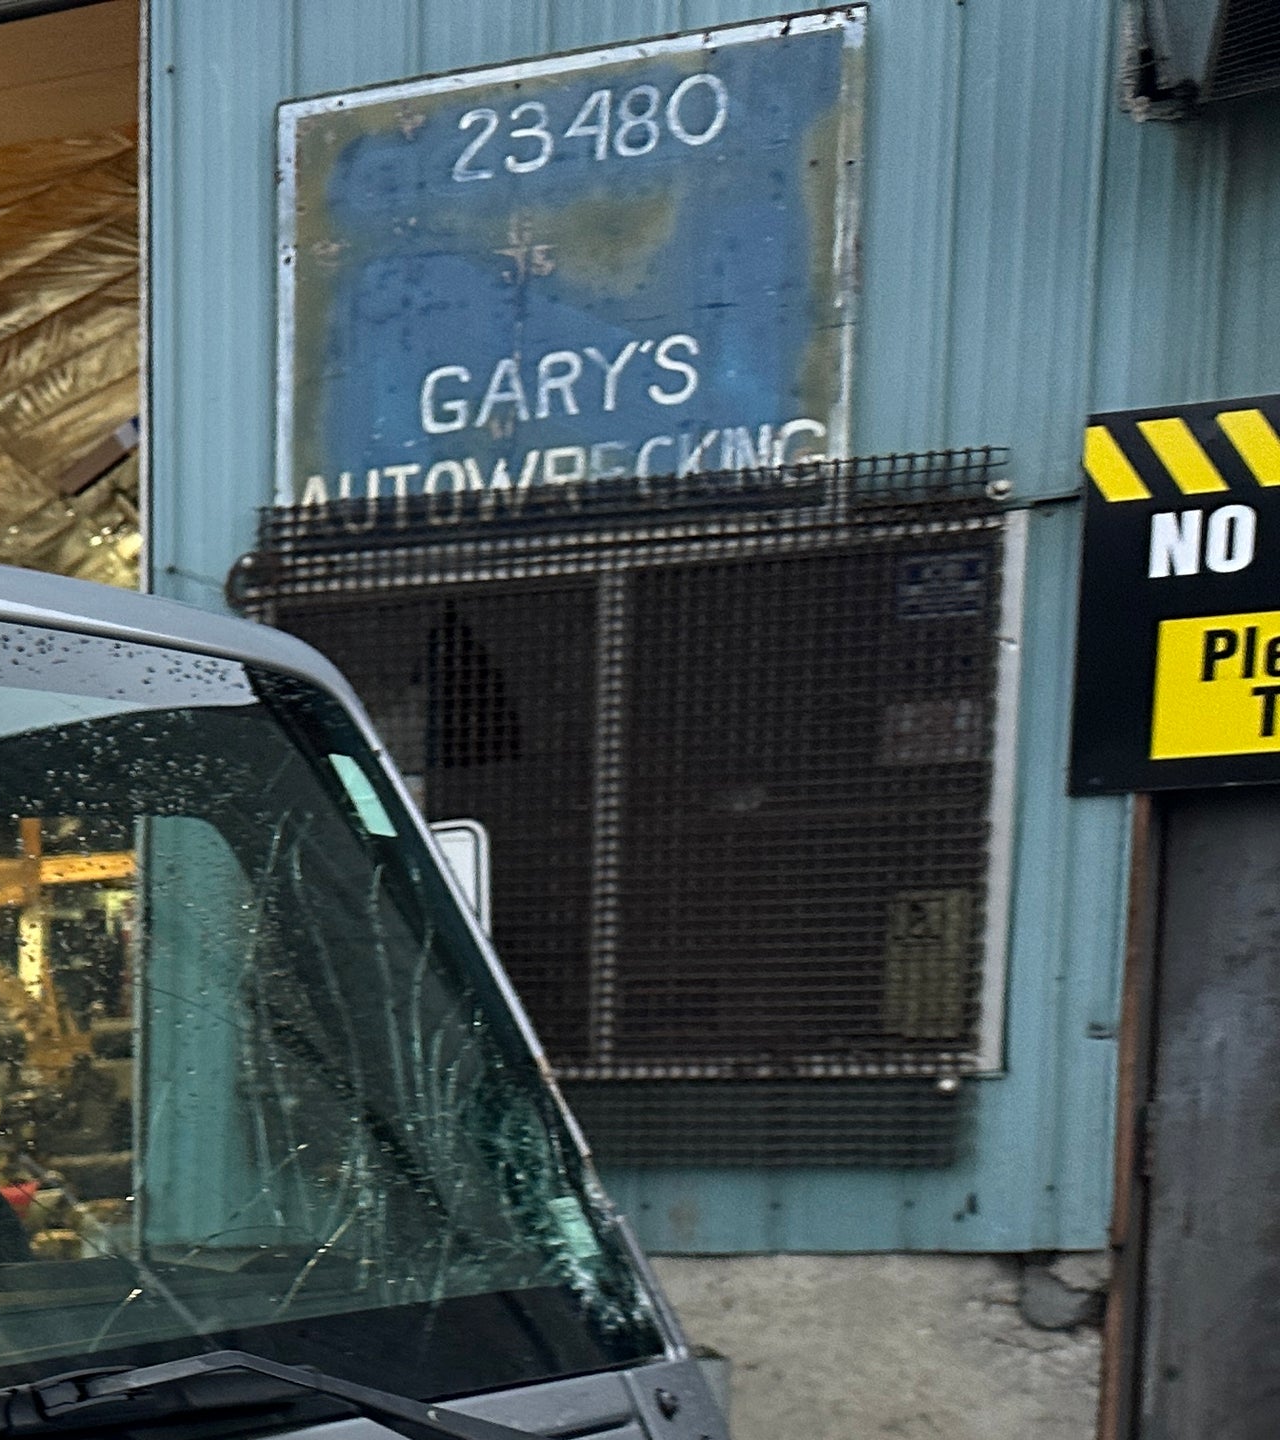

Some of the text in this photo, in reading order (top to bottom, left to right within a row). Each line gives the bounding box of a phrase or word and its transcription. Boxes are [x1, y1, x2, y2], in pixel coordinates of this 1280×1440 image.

[451, 73, 729, 184] 23480
[420, 335, 701, 435] GARY'S
[1148, 504, 1257, 579] NO
